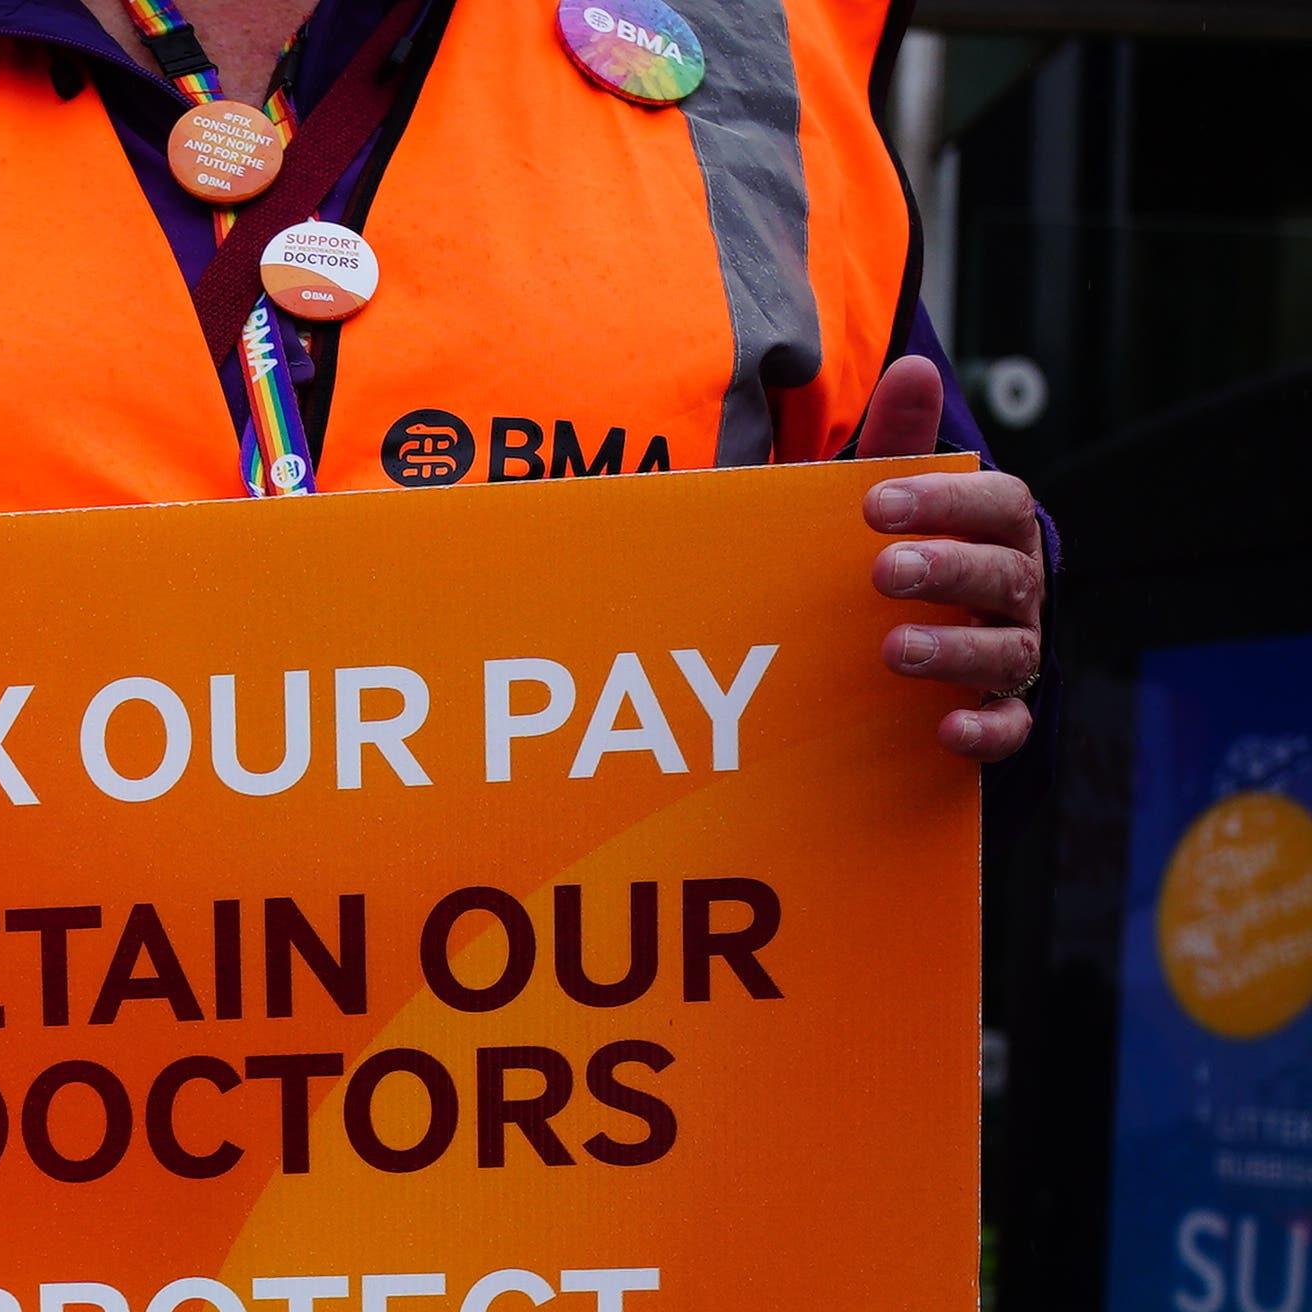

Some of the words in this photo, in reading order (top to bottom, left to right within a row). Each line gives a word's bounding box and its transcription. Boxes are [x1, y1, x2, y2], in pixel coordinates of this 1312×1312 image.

[616, 18, 684, 66] BMA
[192, 115, 274, 147] CONSULTANT
[223, 112, 252, 128] #FIX
[202, 130, 226, 145] PAY
[226, 138, 256, 154] NOW
[184, 139, 212, 154] AND
[213, 147, 240, 162] FOR
[241, 154, 266, 171] THE
[196, 154, 246, 177] FUTURE
[207, 176, 232, 191] BMA
[285, 233, 361, 250] SUPPORT
[283, 251, 359, 270] DOCTORS
[311, 291, 334, 302] BMA
[81, 666, 433, 802] OUR
[485, 645, 779, 783] PAY
[419, 876, 786, 1013] OUR
